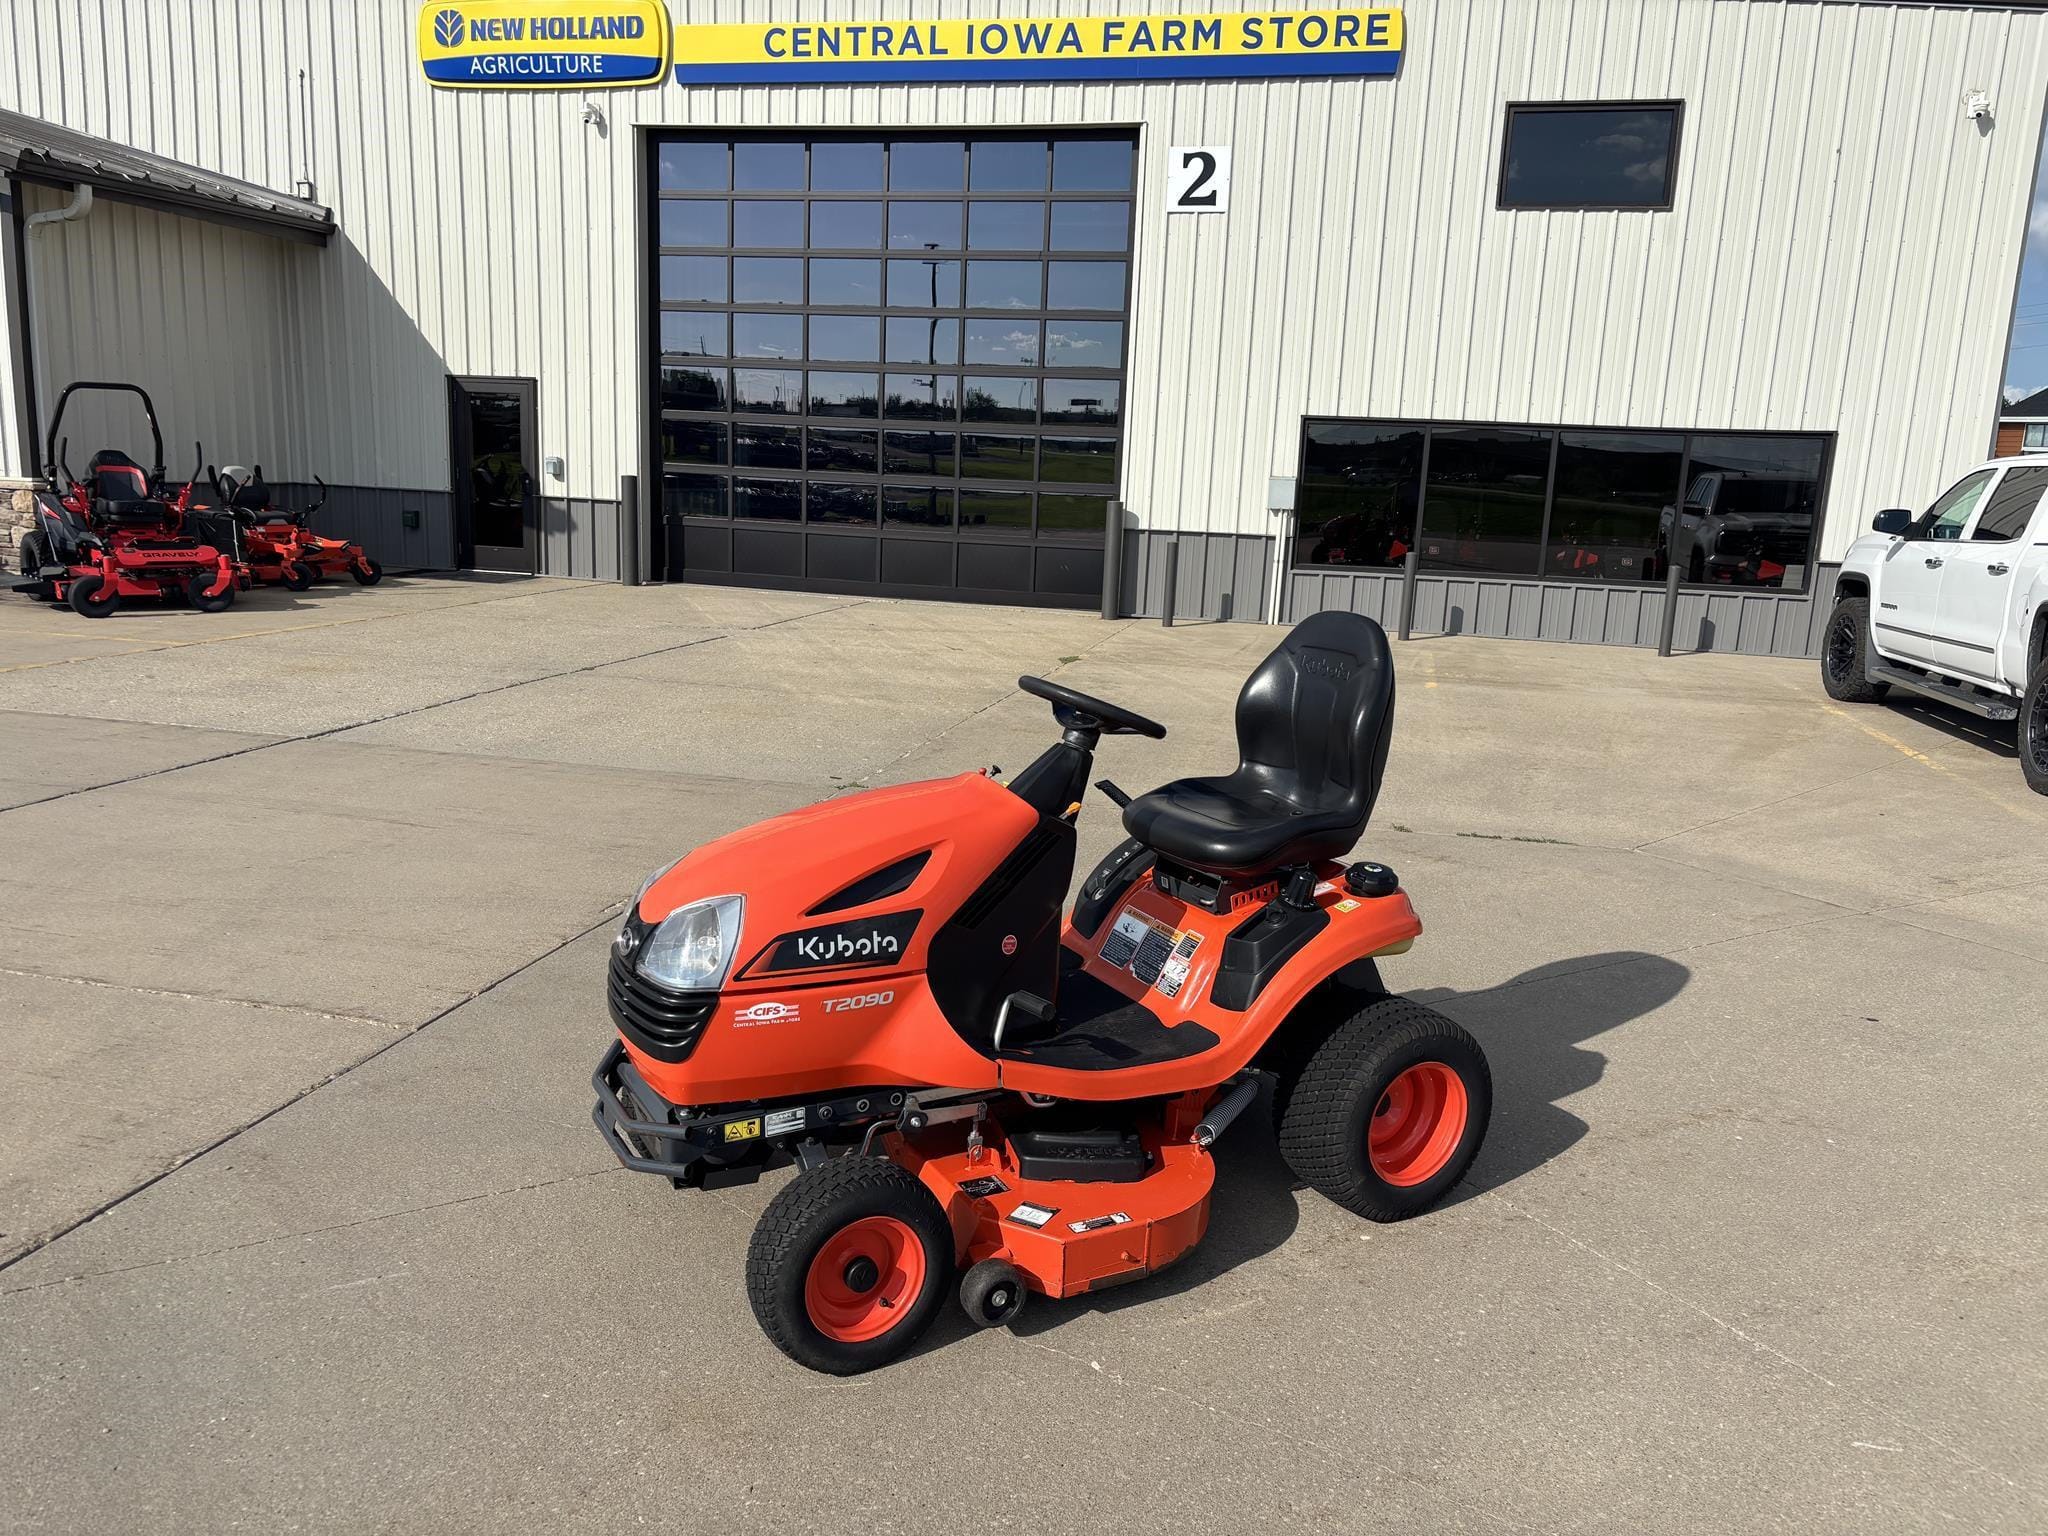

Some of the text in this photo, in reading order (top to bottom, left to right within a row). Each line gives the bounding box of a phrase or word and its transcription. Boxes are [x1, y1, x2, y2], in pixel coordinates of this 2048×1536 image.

[470, 15, 645, 42] NEW HOLLAND
[763, 13, 1391, 57] CENTRAL IOWA FARM STORE
[470, 55, 603, 75] AGRICULTURE
[1177, 151, 1217, 206] 2
[141, 551, 199, 559] GRAVELY
[797, 930, 898, 961] Kubota
[753, 1005, 781, 1017] CIFS
[822, 990, 895, 1013] T2090
[733, 1020, 755, 1028] CENTRAL
